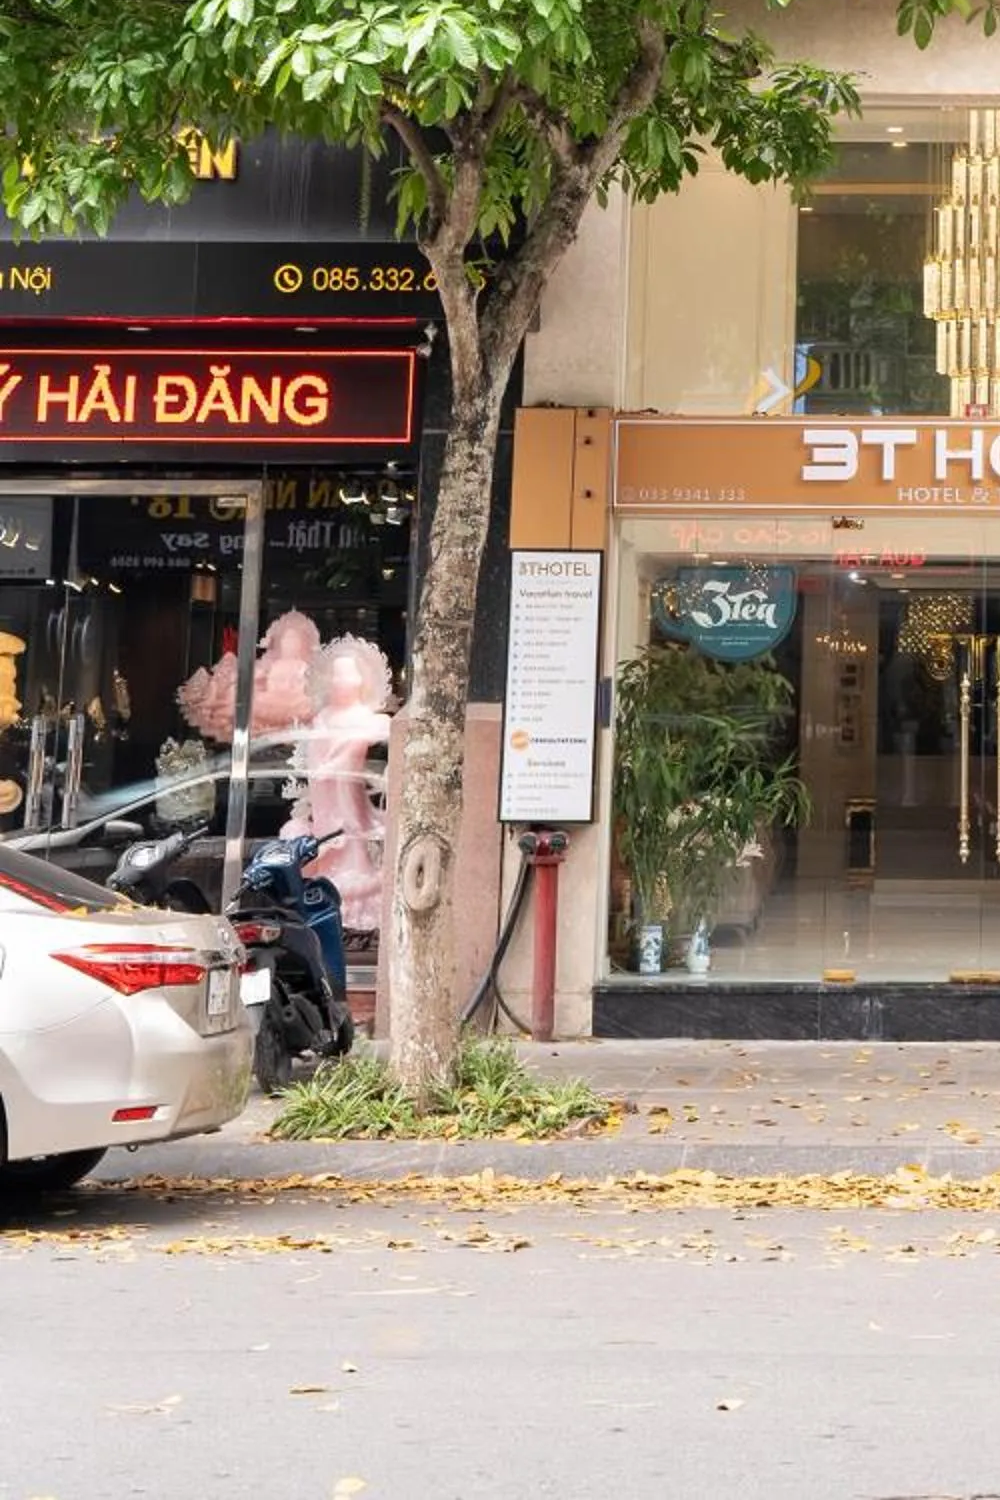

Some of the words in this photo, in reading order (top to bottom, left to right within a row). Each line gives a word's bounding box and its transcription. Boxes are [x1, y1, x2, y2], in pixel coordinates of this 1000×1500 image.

[10, 266, 51, 295] Nội
[37, 365, 136, 423] HẢI
[154, 365, 329, 426] ĐĂNG
[897, 486, 965, 503] HOTEL
[971, 486, 990, 503] &
